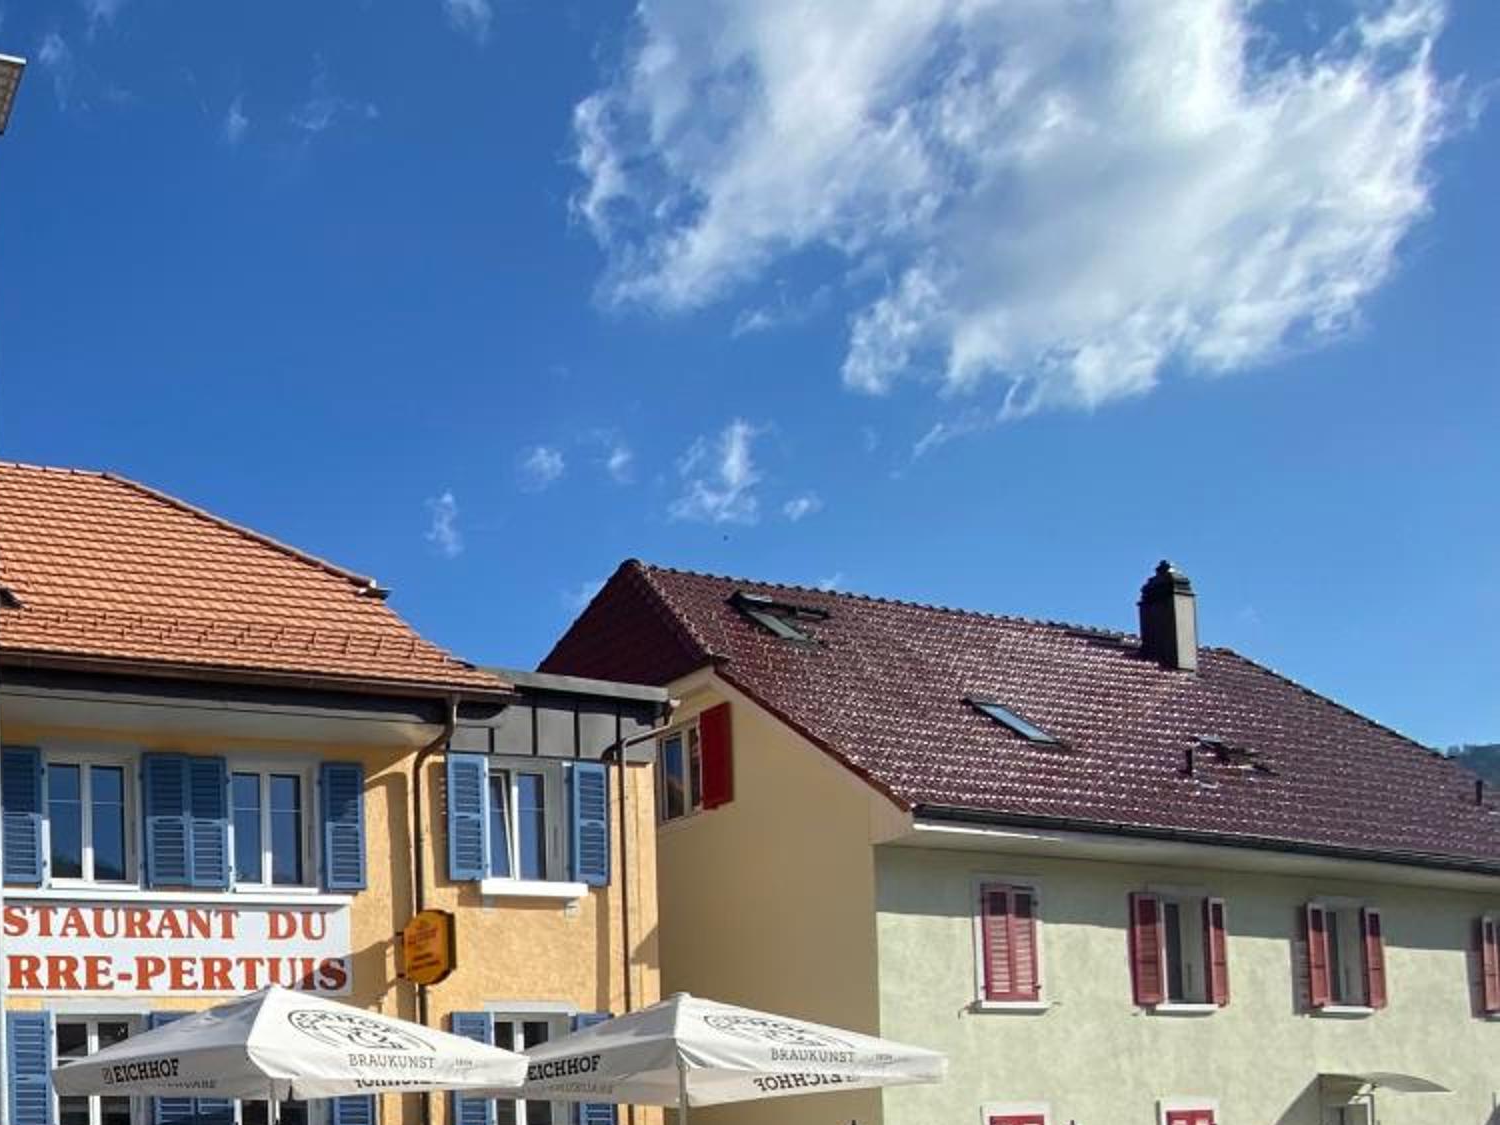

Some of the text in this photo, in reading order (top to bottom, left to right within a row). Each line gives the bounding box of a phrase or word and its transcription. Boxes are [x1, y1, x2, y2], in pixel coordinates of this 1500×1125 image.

[267, 911, 327, 941] DU
[348, 1053, 436, 1069] BRAUKUNST
[527, 1055, 601, 1081] EICHHOF
[771, 1048, 854, 1063] BRAUKUNST
[113, 1058, 179, 1083] EICHHOF
